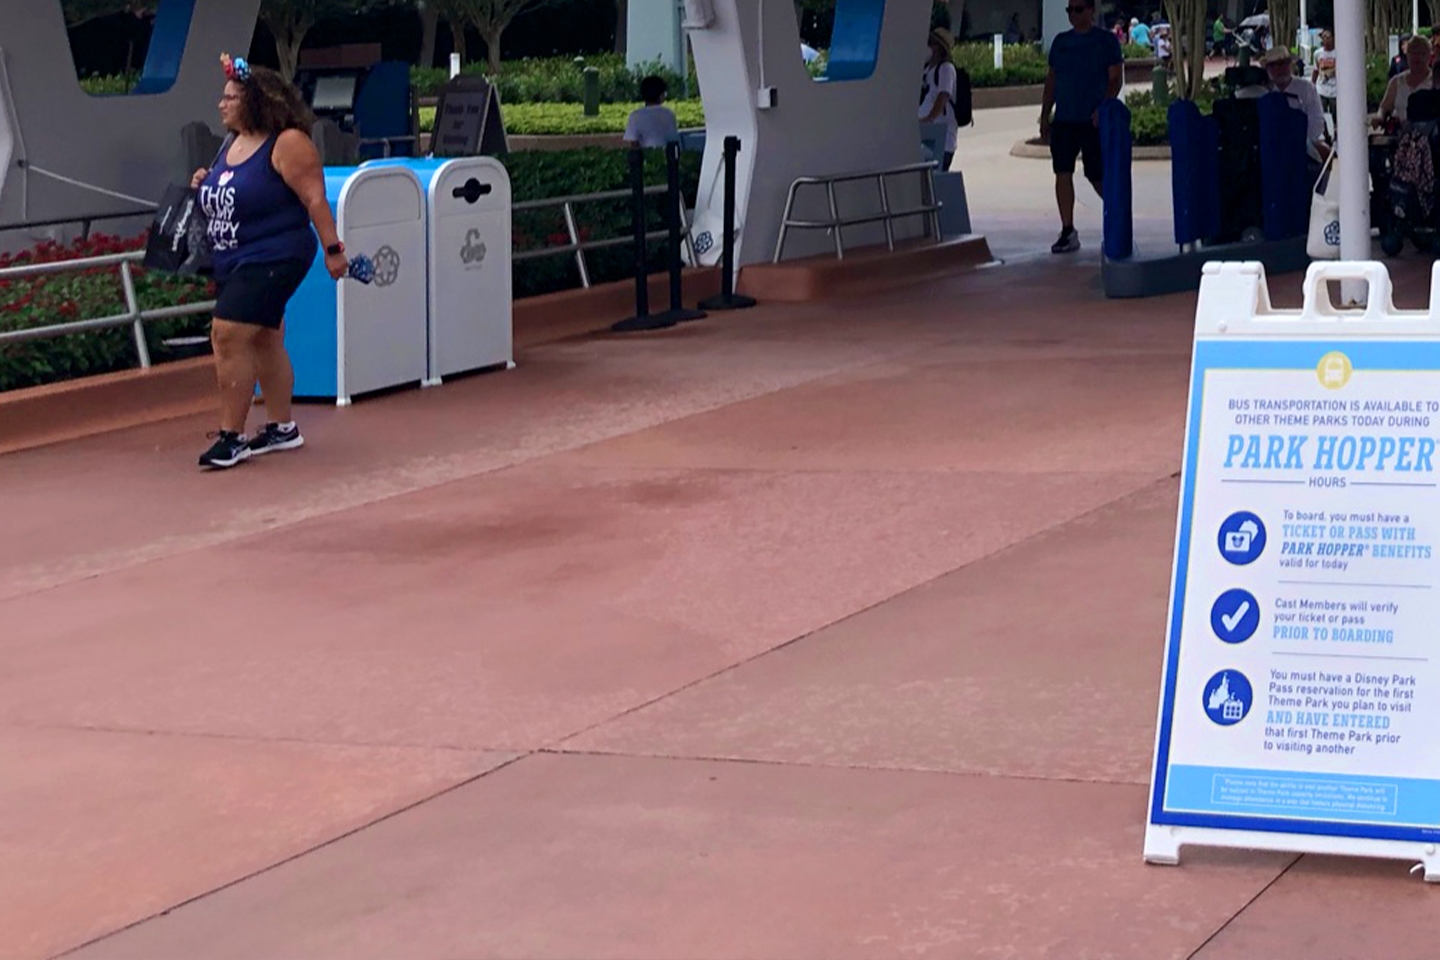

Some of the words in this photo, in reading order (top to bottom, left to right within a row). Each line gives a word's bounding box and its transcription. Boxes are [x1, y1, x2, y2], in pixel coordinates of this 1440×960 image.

[200, 185, 236, 206] THIS
[216, 205, 235, 220] MY
[1229, 399, 1250, 410] BUS
[1254, 400, 1346, 411] TRANSPORTATION
[1350, 401, 1360, 411] IS
[1363, 401, 1422, 411] AVAILABLE
[1427, 402, 1439, 412] TO
[1235, 415, 1269, 424] OTHER
[1274, 415, 1309, 425] THEME
[1313, 416, 1348, 426] PARKS
[1352, 416, 1385, 426] TODAY
[1388, 417, 1430, 427] DURING
[1224, 434, 1307, 469] PARK
[1309, 477, 1346, 488] HOURS
[1284, 510, 1293, 519] To
[1330, 513, 1346, 523] you
[1350, 513, 1374, 522] must
[1378, 513, 1399, 523] have
[1403, 515, 1409, 523] a
[1283, 525, 1326, 538] TICKET
[1330, 526, 1344, 539] OR
[1349, 526, 1378, 540] PASS
[1382, 527, 1415, 540] WITH
[1281, 542, 1313, 555] PARK
[1372, 545, 1431, 558] BENEFITS
[1280, 558, 1301, 568] valid
[1305, 558, 1319, 568] for
[1322, 559, 1348, 571] today
[1275, 599, 1296, 608] Cast
[1300, 600, 1346, 610] Members
[1350, 601, 1367, 611] will
[1371, 601, 1398, 614] verify
[1274, 613, 1295, 622] your
[1299, 612, 1326, 622] ticket
[1329, 614, 1339, 623] or
[1342, 615, 1365, 625] pass
[1273, 626, 1309, 640] PRIOR
[1313, 627, 1328, 641] TO
[1332, 628, 1394, 643] BOARDING
[1270, 669, 1287, 679] You
[1291, 670, 1315, 680] must
[1319, 671, 1342, 682] have
[1346, 674, 1351, 682] a
[1355, 673, 1388, 686] Disney
[1392, 674, 1416, 686] Park
[1269, 683, 1292, 693] Pass
[1296, 684, 1353, 695] reservation
[1357, 686, 1371, 696] for
[1374, 687, 1390, 697] the
[1393, 687, 1413, 698] first
[1268, 696, 1301, 706] Theme
[1305, 697, 1328, 707] Park
[1332, 700, 1349, 710] you
[1353, 699, 1374, 711] plan
[1378, 700, 1386, 710] to
[1390, 700, 1411, 711] visit
[1267, 711, 1292, 724] AND
[1296, 712, 1328, 725] HAVE
[1332, 714, 1390, 728] ENTERED
[1265, 727, 1284, 737] that
[1288, 728, 1308, 738] first
[1312, 729, 1345, 740] Theme
[1349, 731, 1372, 742] Park
[1376, 732, 1400, 744] prior
[1264, 741, 1273, 750] to
[1276, 741, 1312, 754] visiting
[1316, 743, 1355, 754] another
